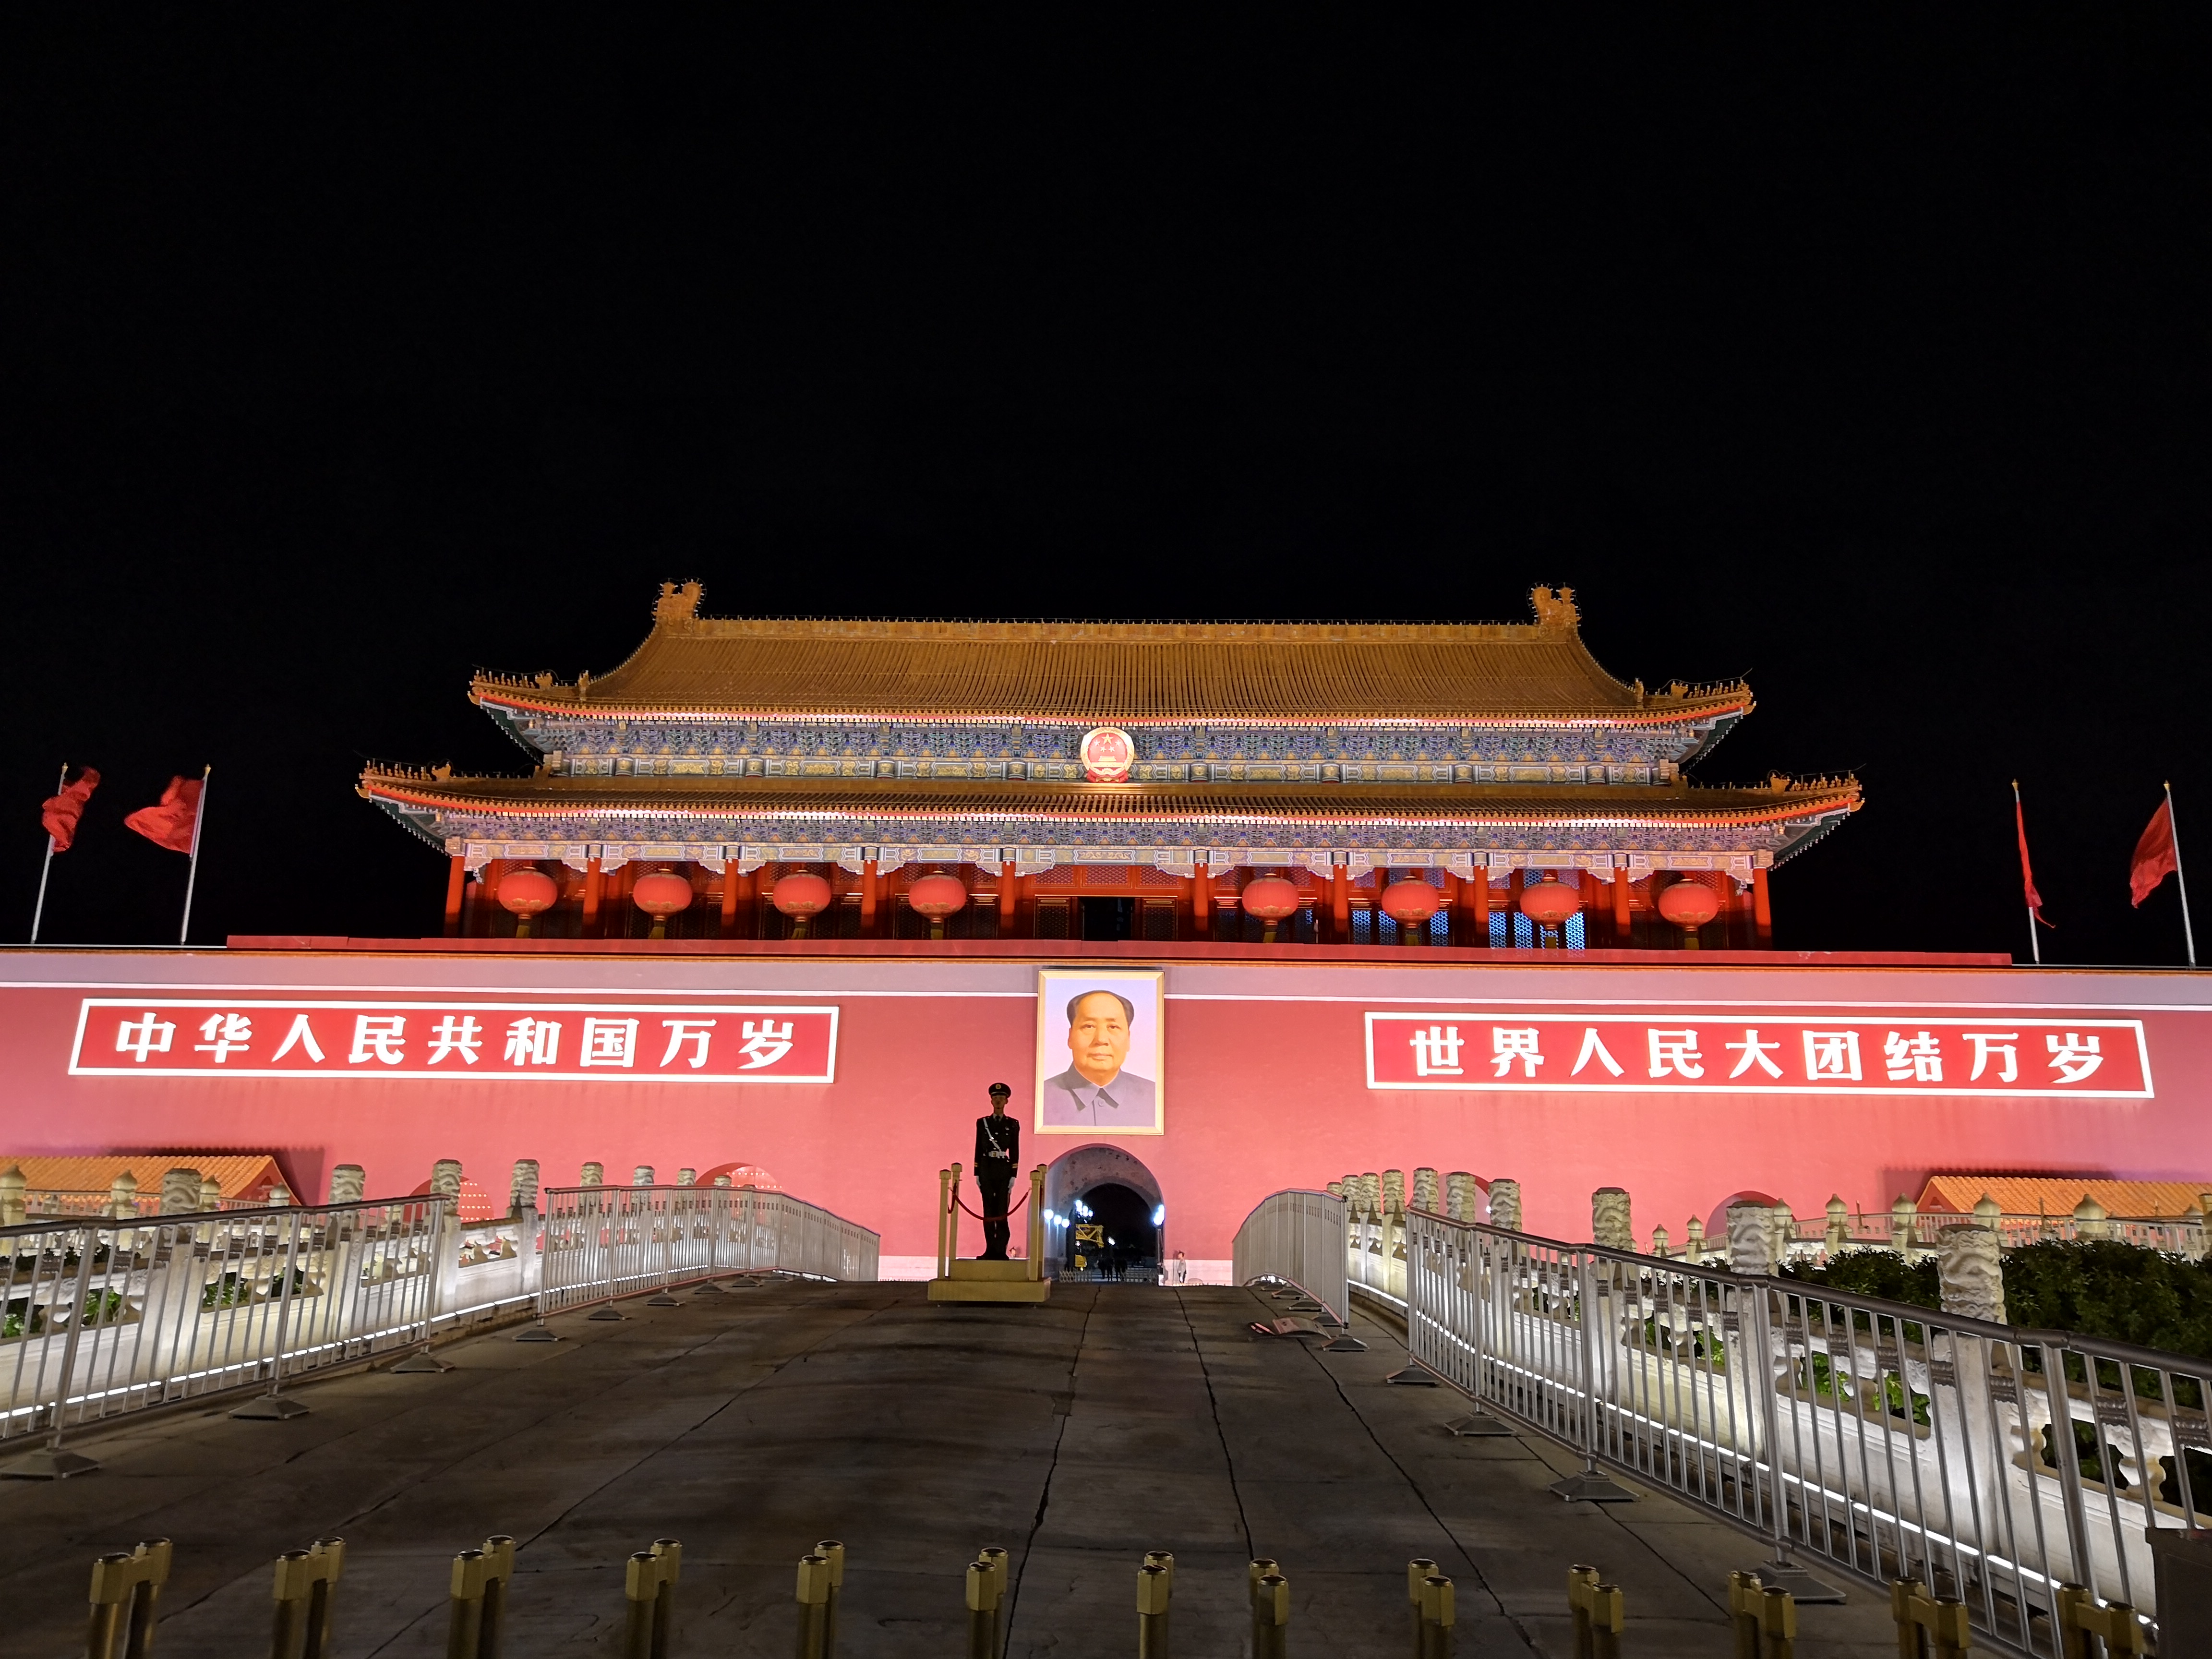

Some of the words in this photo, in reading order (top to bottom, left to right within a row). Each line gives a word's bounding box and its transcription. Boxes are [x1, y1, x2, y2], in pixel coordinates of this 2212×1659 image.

[116, 1011, 794, 1070] 中华人民共和国万岁
[1409, 1026, 2104, 1084] 世界人民大团结万岁
